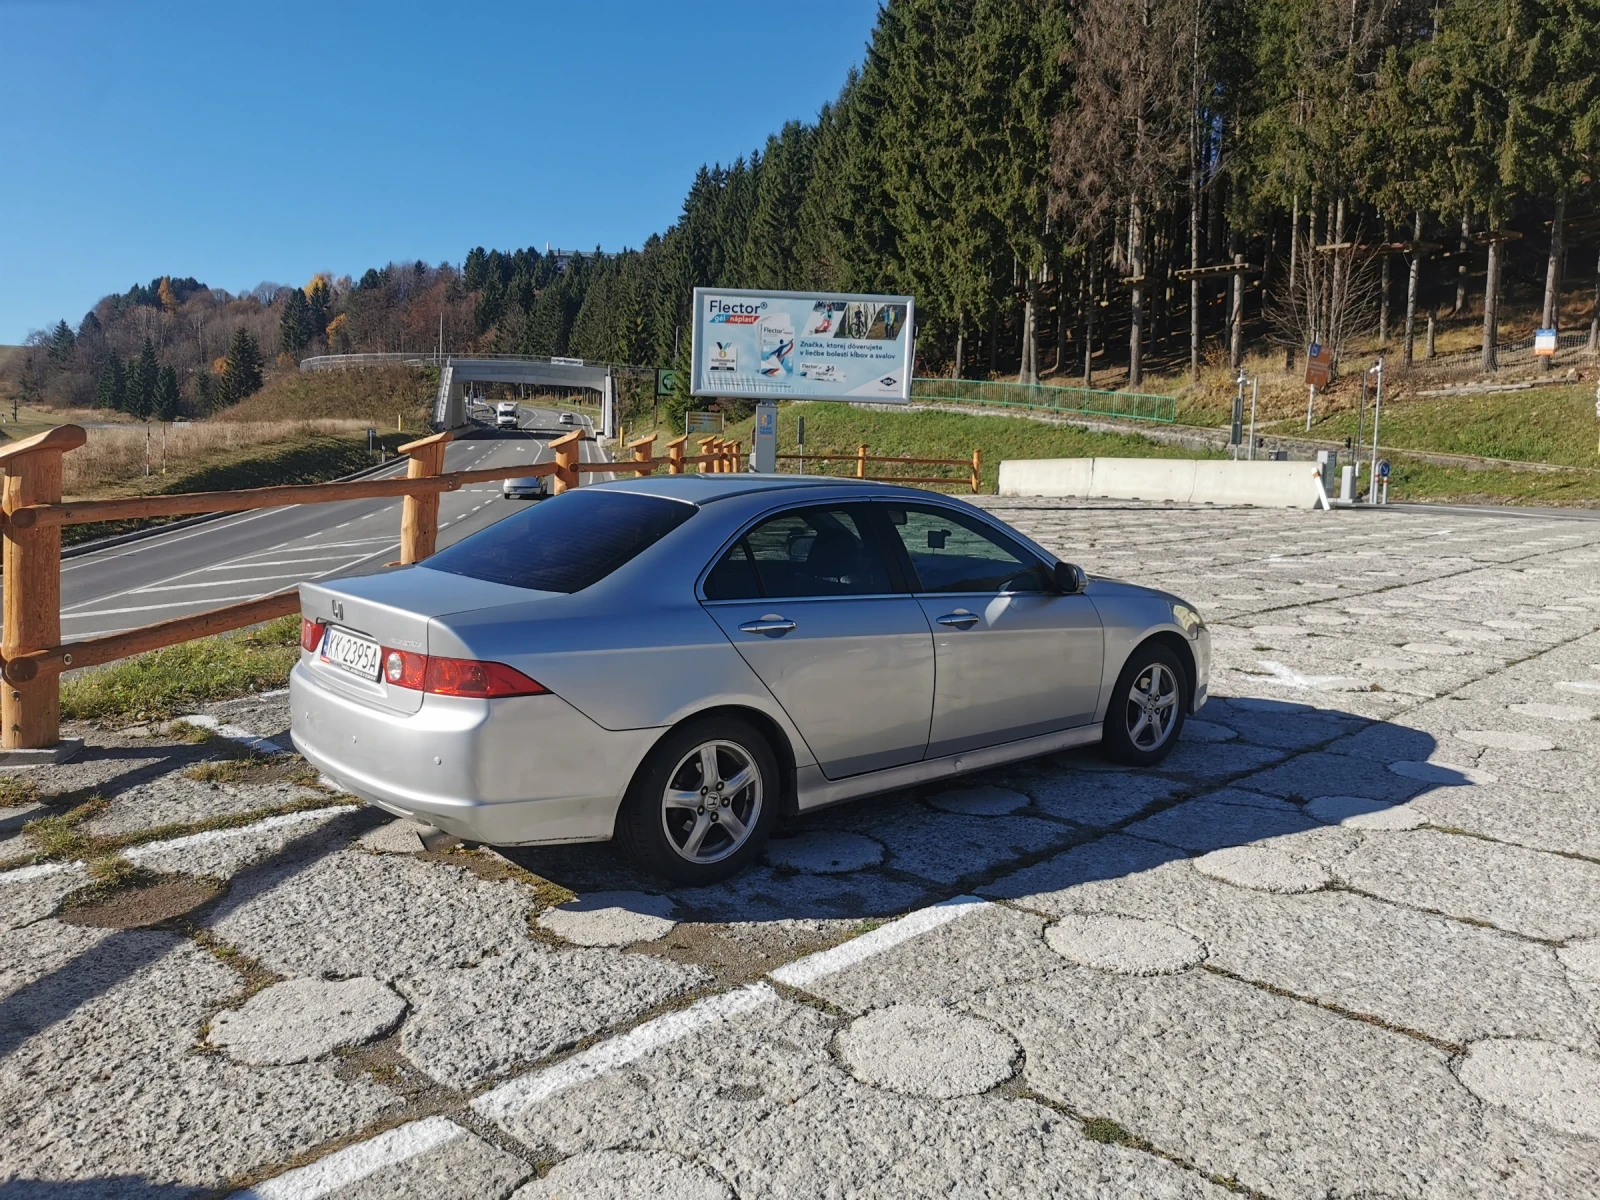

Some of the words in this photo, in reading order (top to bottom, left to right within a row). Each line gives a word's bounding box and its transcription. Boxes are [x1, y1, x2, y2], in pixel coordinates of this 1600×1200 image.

[800, 341, 825, 349] Značka,
[826, 342, 846, 350] ktorej
[847, 342, 883, 351] dôverujete
[826, 350, 849, 358] bolesti
[328, 633, 344, 660] KK
[342, 638, 378, 673] 2395A
